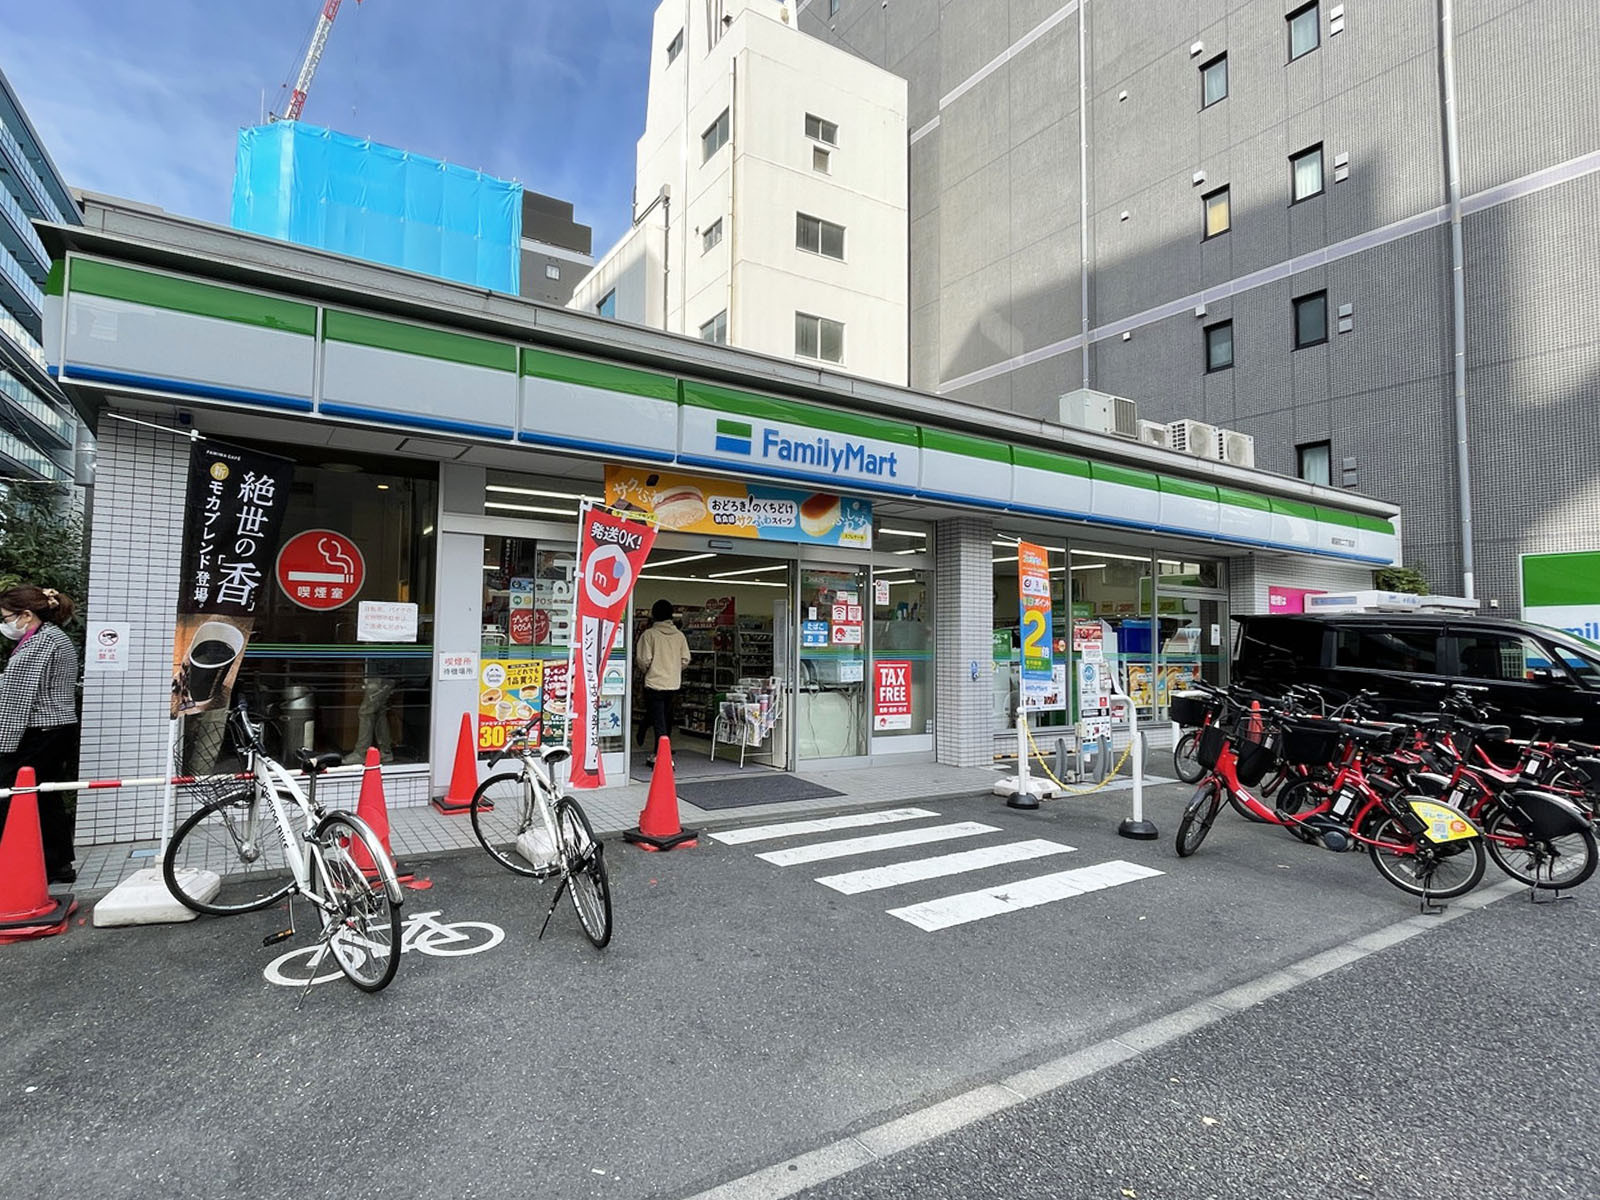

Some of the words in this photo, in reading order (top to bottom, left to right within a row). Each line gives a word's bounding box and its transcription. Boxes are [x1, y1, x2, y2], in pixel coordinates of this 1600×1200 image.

[763, 428, 897, 477] FamilyMart
[591, 521, 643, 550] 発送OK!
[297, 586, 344, 600] 喫煙室
[880, 668, 905, 686] TAX
[880, 686, 906, 702] FREE
